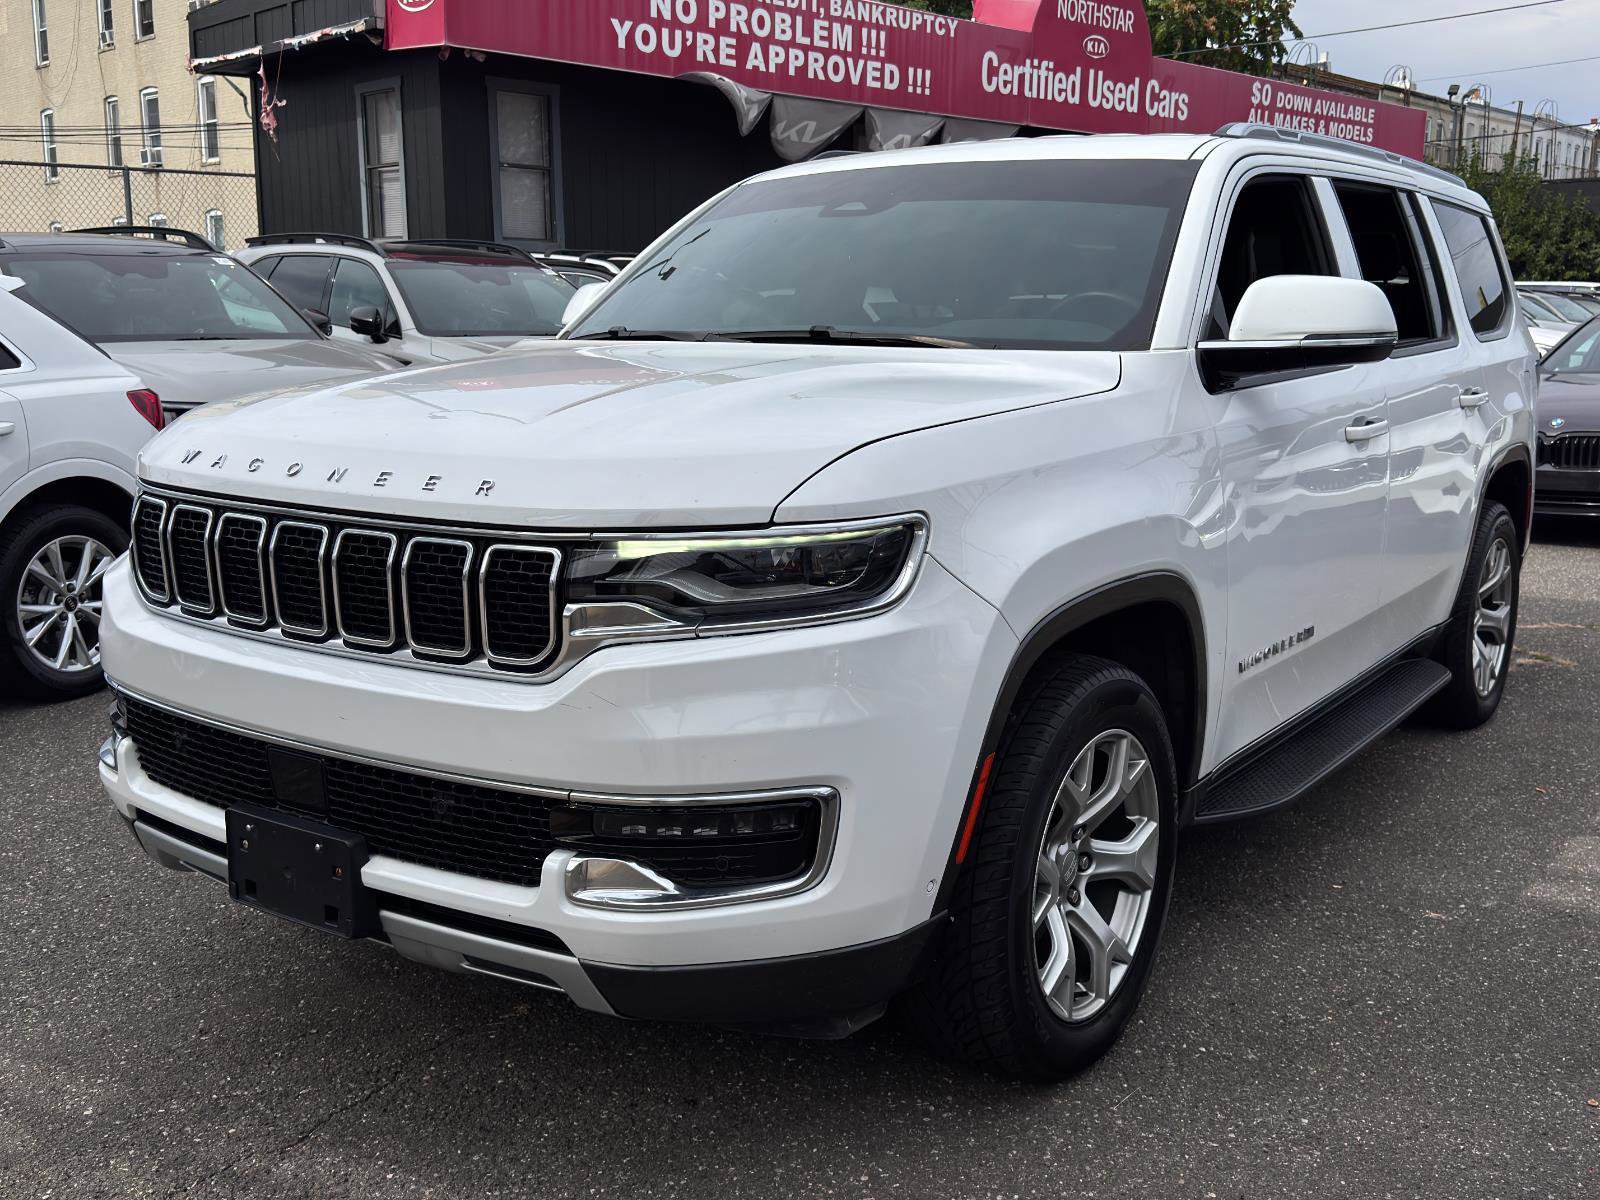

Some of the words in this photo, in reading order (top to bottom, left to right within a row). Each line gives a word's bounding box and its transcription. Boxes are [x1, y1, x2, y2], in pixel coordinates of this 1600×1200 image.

[650, 0, 698, 24] NO
[708, 0, 853, 52] PROBLEM
[861, 27, 886, 58] !!!
[830, 0, 959, 38] BANKRUPTCY
[1057, 0, 1134, 34] NORTHSTAR
[610, 18, 737, 68] YOU'RE
[745, 42, 900, 91] APPROVED
[907, 66, 931, 96] !!!
[981, 50, 1082, 105] Certified
[1087, 68, 1140, 114] Used
[1145, 79, 1189, 121] Cars
[1251, 79, 1272, 107] $0
[1276, 91, 1312, 114] DOWN
[1314, 99, 1376, 124] AVAILABLE
[1248, 108, 1270, 126] ALL
[1274, 112, 1316, 134] MAKES
[1318, 119, 1326, 134] &
[1328, 121, 1374, 143] MODELS
[180, 449, 496, 497] WAGONEER
